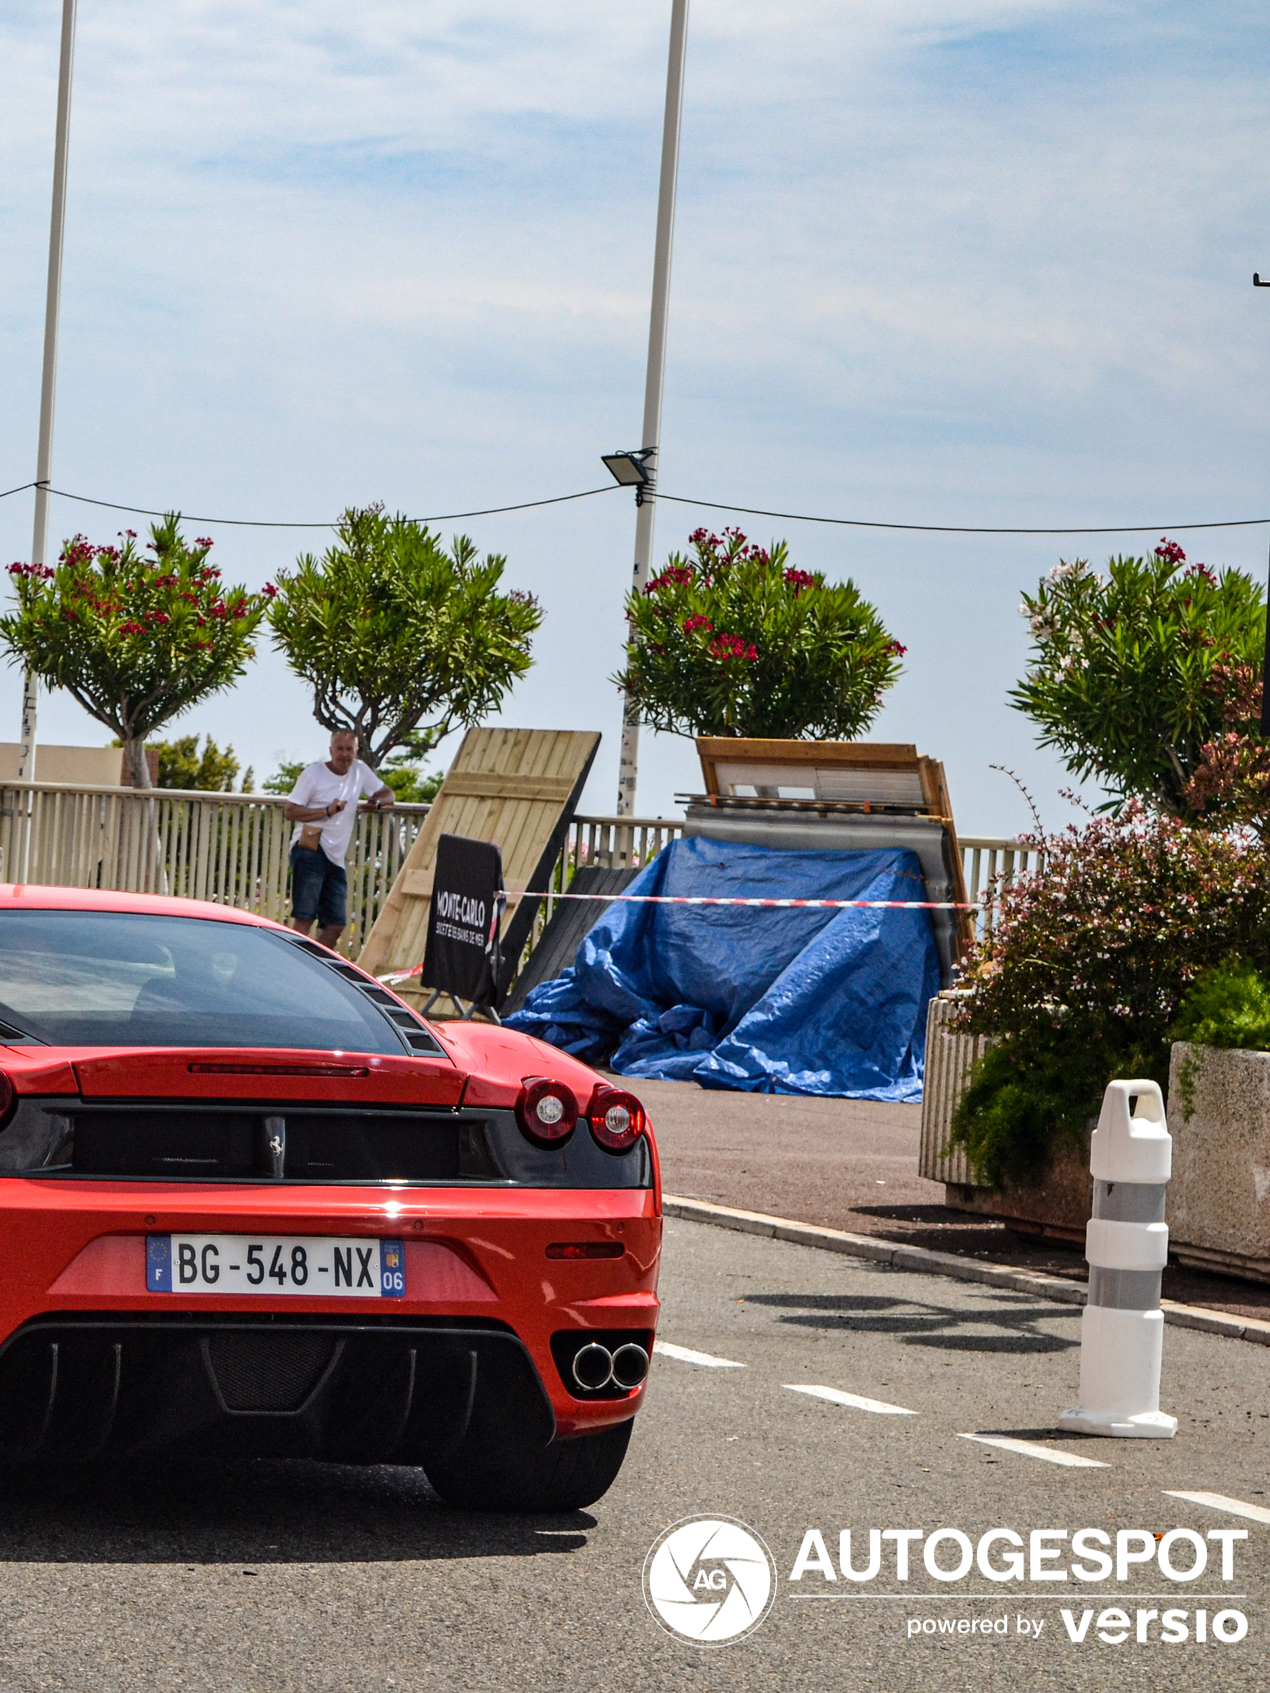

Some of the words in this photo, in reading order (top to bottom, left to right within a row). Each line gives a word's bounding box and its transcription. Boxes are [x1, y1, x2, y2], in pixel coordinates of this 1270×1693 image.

[437, 890, 485, 928] MONTE-CARLO
[155, 1268, 163, 1281] F
[383, 1272, 403, 1290] 06
